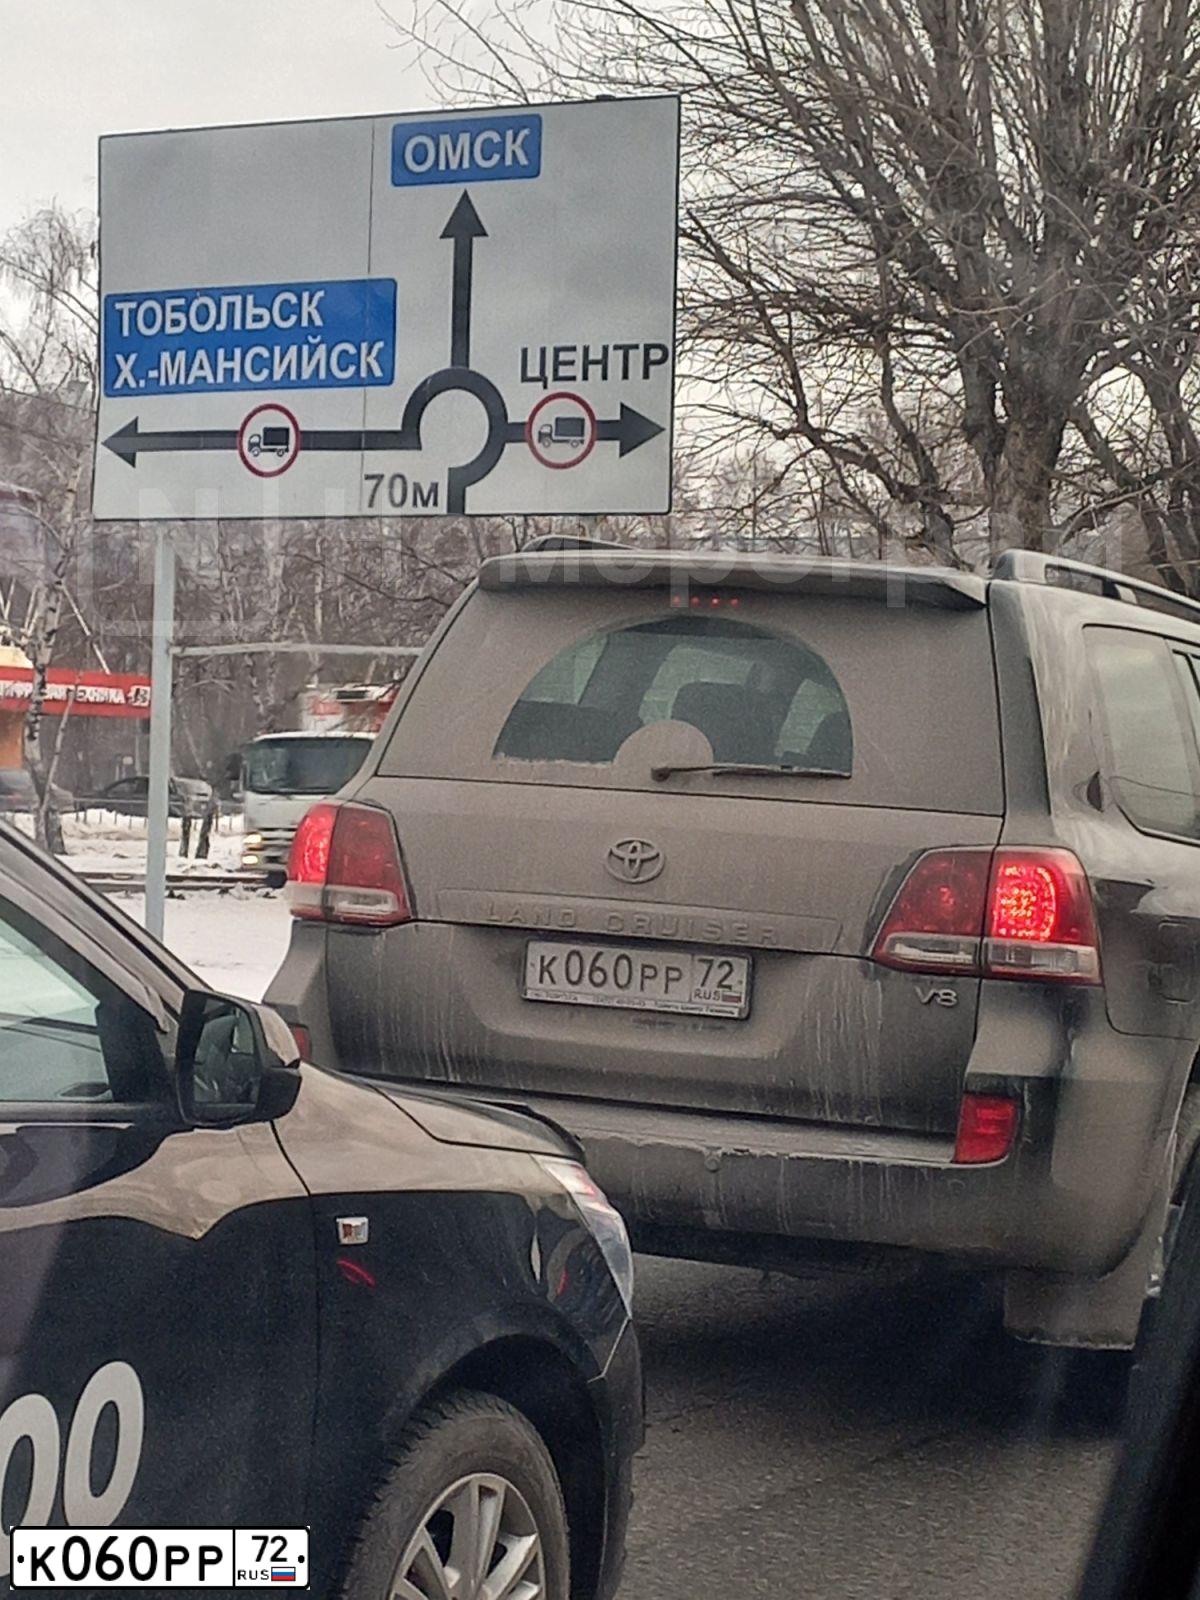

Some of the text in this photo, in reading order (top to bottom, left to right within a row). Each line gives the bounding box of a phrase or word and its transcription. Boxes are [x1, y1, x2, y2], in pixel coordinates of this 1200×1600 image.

[403, 127, 530, 174] ОМСК
[114, 289, 325, 338] ТОБОЛЬСК
[113, 334, 385, 390] Х.-МАНСИЙСК
[519, 343, 669, 389] ЦЕНТР
[362, 474, 439, 509] 70м
[486, 905, 779, 946] LAND CRUISER
[538, 949, 736, 995] К060РР 72
[693, 988, 721, 1002] RUS
[914, 985, 958, 1007] V8
